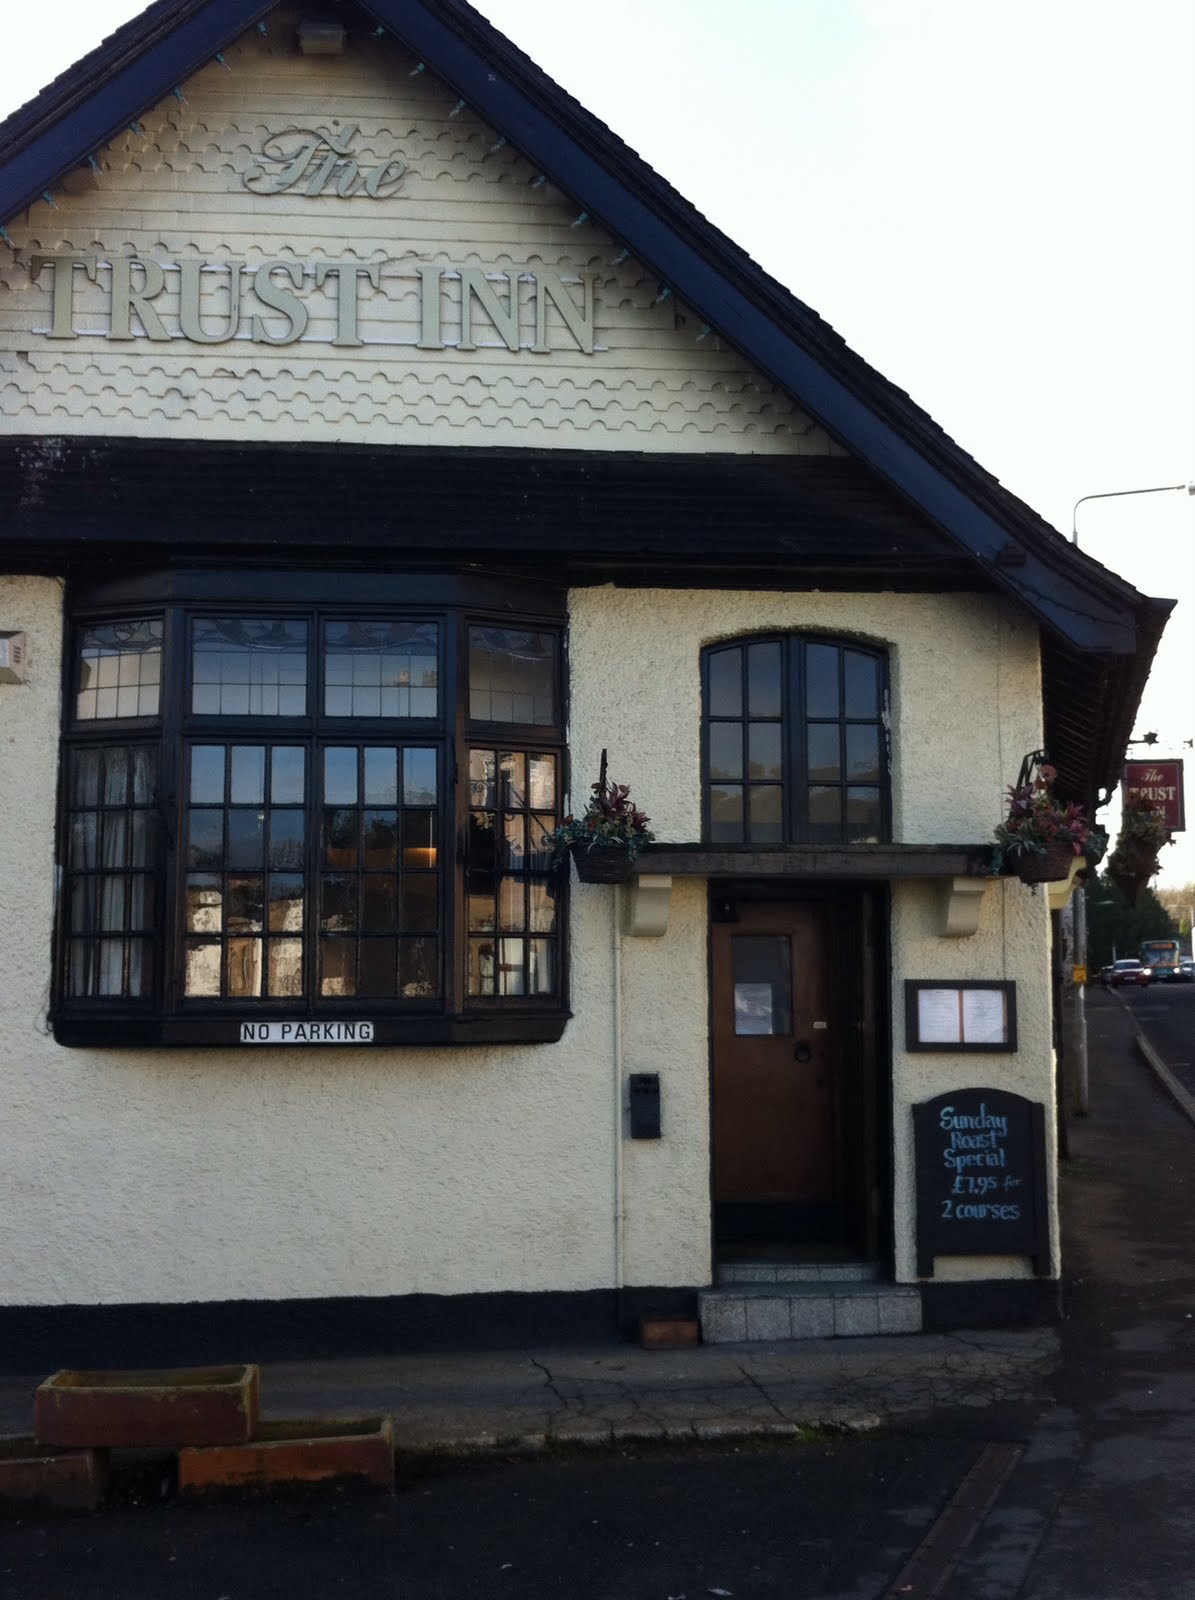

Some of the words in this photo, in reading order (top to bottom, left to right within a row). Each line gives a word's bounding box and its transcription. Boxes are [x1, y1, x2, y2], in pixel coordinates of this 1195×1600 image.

[242, 122, 408, 199] The
[32, 255, 382, 346] TRUST
[416, 266, 600, 354] INN
[1140, 768, 1165, 782] The
[243, 1024, 270, 1040] NO
[281, 1024, 371, 1040] PARKING
[939, 1103, 1008, 1136] Sunday
[951, 1130, 997, 1149] Roast
[943, 1148, 1006, 1173] Special
[941, 1199, 954, 1218] 2
[956, 1203, 1020, 1220] courses
